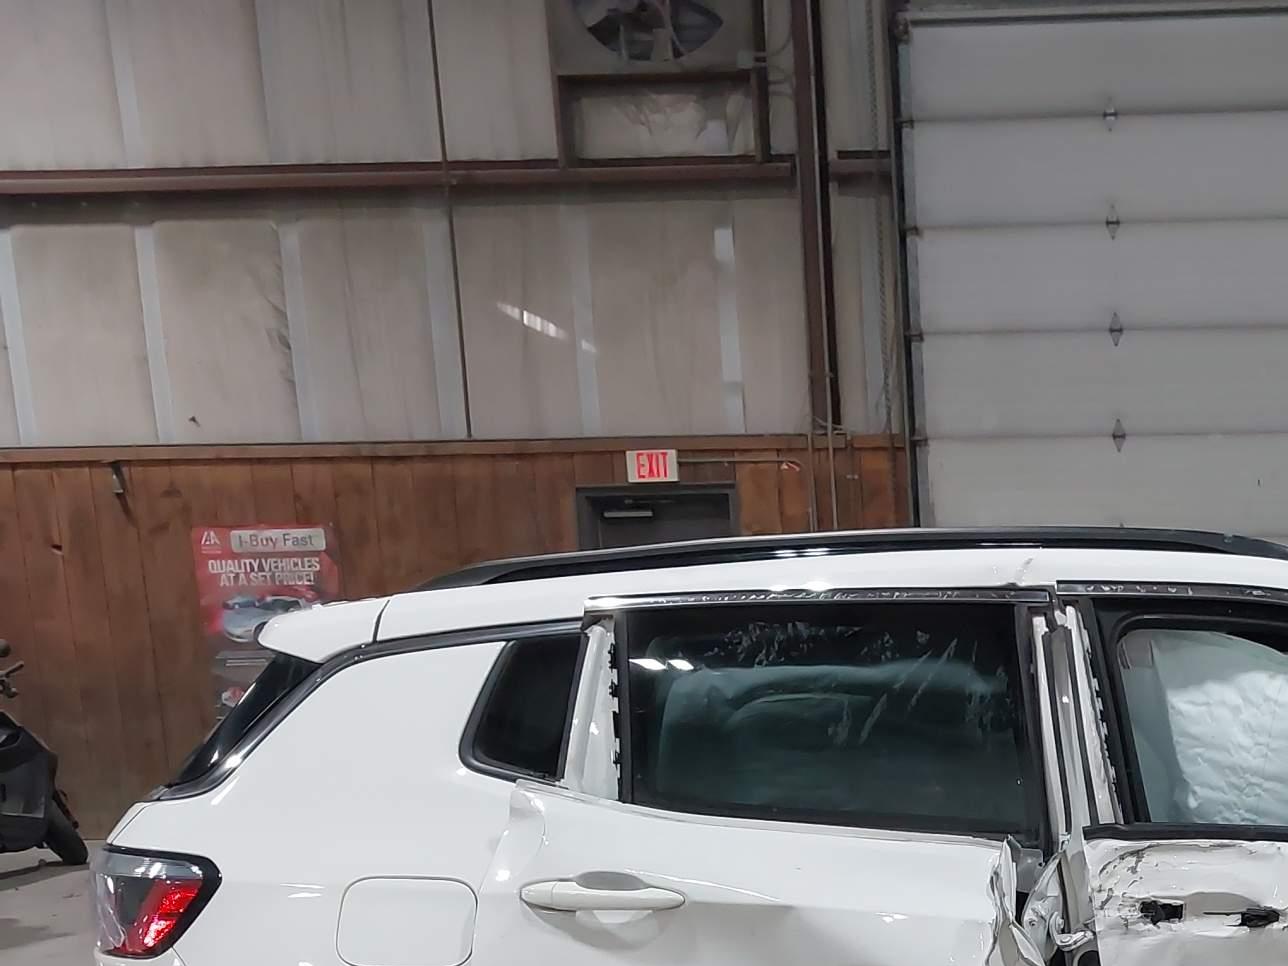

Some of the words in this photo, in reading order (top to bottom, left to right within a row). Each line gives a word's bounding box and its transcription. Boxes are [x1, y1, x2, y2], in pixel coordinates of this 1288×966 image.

[636, 452, 668, 479] EXIT
[239, 533, 278, 548] I-Buy
[282, 532, 315, 547] Fast
[208, 559, 260, 573] QUALITY
[260, 557, 320, 572] VEHICLES
[220, 572, 236, 586] AT
[239, 572, 249, 586] A
[249, 572, 273, 586] SET
[275, 571, 315, 585] PRICE!
